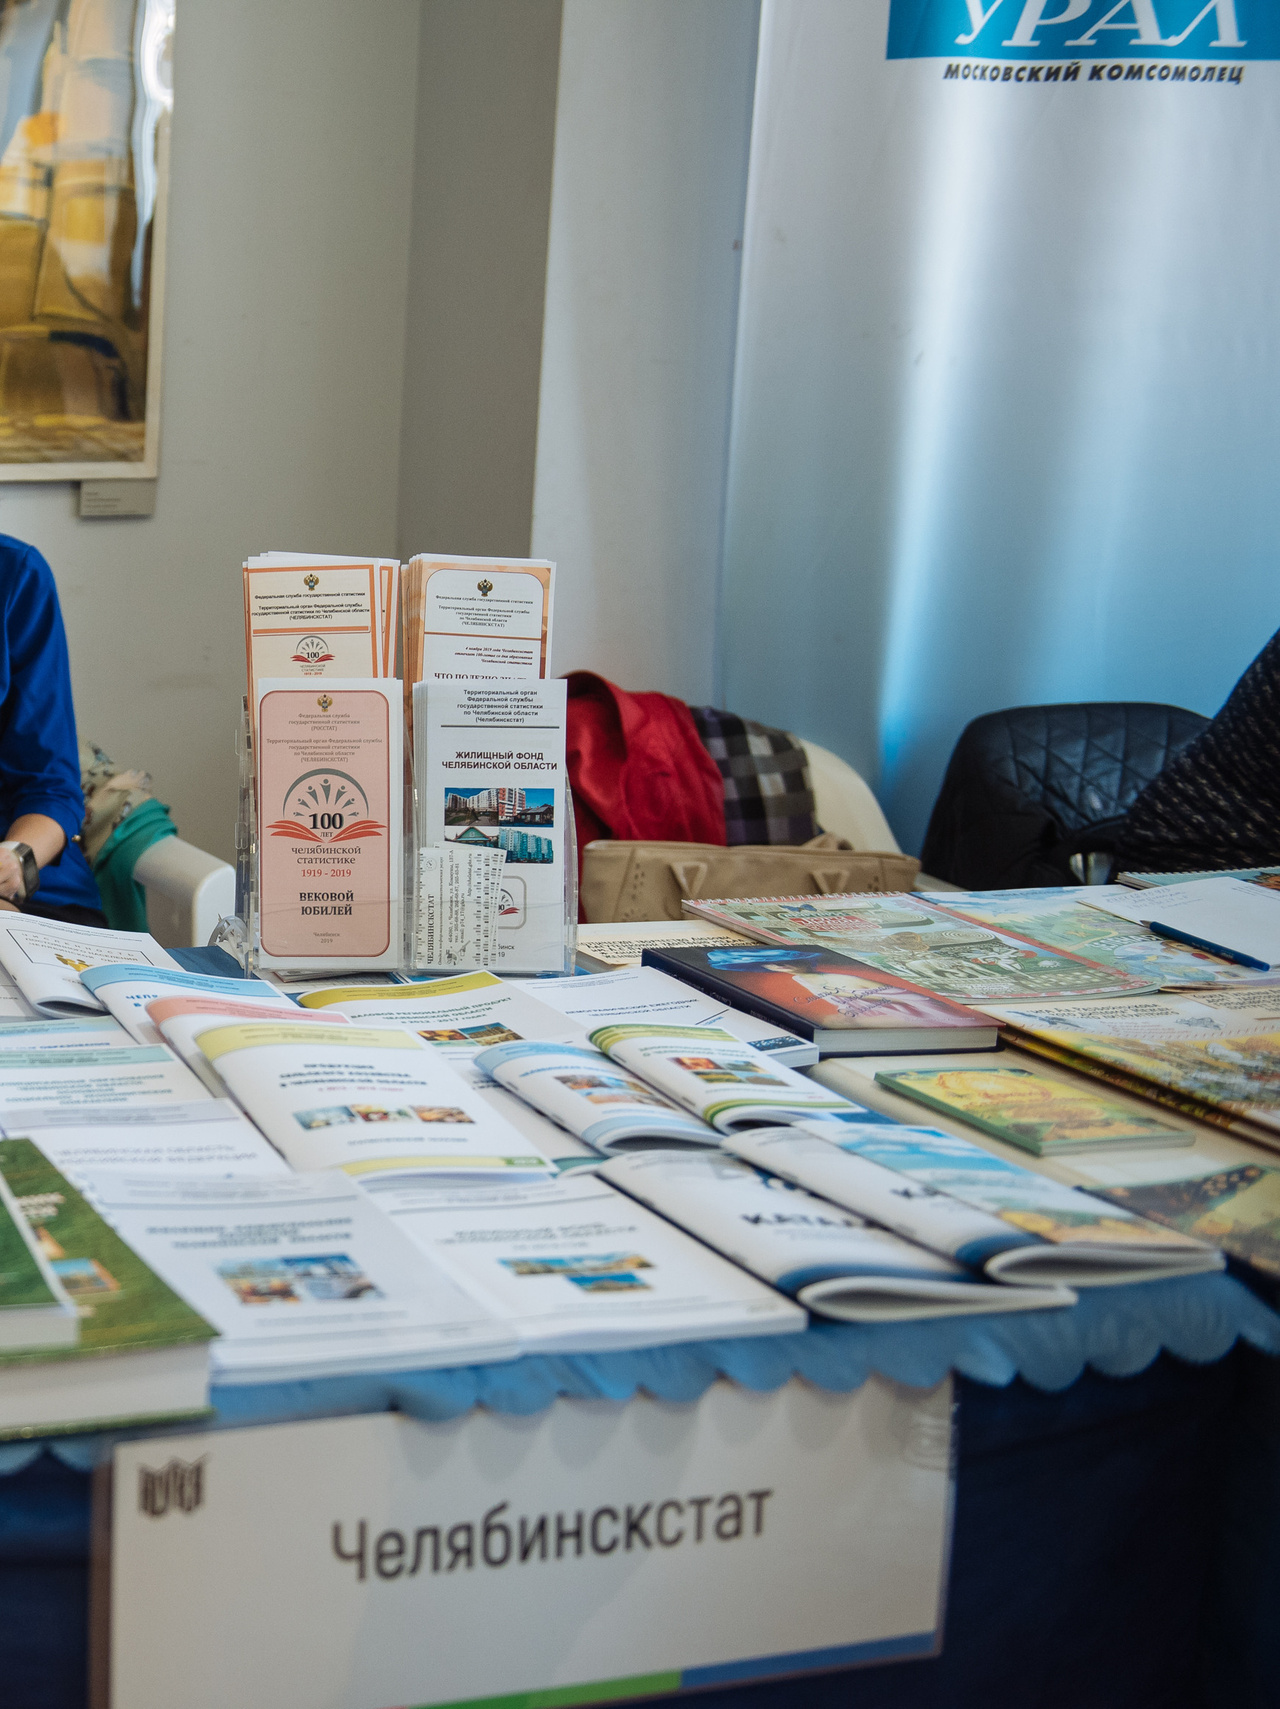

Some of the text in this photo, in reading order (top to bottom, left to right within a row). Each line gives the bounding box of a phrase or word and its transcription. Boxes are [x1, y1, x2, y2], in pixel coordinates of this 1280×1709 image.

[954, 0, 1249, 48] УРАЛ
[942, 61, 1246, 85] МОСКОВСКИЙ КОМСОМОЛЕЦ
[455, 751, 544, 761] ЖИЛИЩНЫЙ ФОНД
[442, 761, 558, 770] ЧЕЛЯБИНСКОЙ ОБЛАСТИ
[308, 812, 345, 830] 100
[292, 845, 362, 855] челябинской
[301, 868, 352, 878] 1919 2019
[299, 890, 354, 902] ВЕКОВОЙ
[301, 904, 352, 916] ЮБИЛЕЙ
[471, 996, 513, 1008] ПРОДУКТ
[329, 1487, 775, 1585] Челябинскстат
